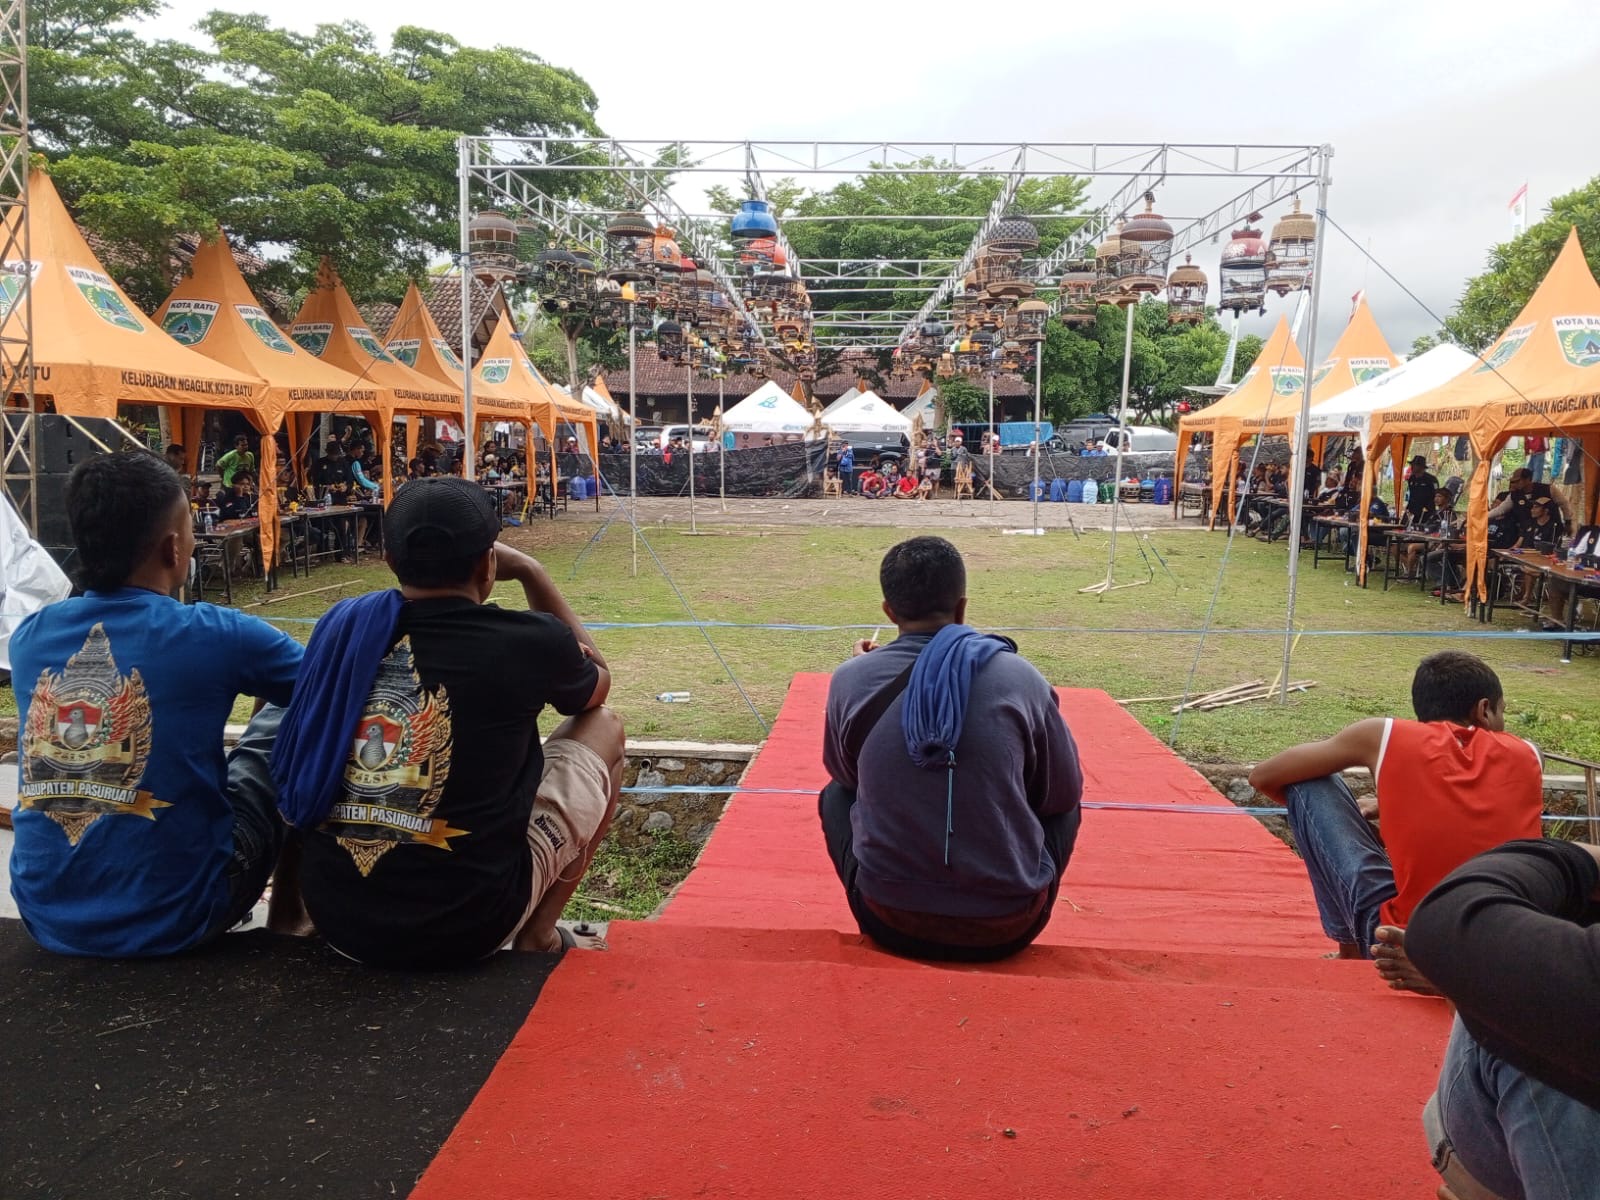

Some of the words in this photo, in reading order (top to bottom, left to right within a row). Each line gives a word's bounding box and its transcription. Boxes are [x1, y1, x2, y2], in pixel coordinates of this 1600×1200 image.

[69, 269, 91, 281] KOTA
[194, 303, 217, 311] BATU
[1556, 318, 1585, 326] KOTA
[121, 370, 177, 389] KELURAHAN
[178, 379, 214, 394] NGAGLIK
[215, 383, 234, 396] KOTA
[234, 384, 253, 397] BATU
[288, 388, 325, 401] KELURAHAN
[1505, 402, 1550, 417] KELURAHAN
[1551, 396, 1588, 414] NGAGLIK
[1383, 410, 1411, 423] KELURAHAN
[1437, 409, 1452, 422] KOTA
[1453, 408, 1471, 421] BATU
[22, 782, 75, 797] KABUPATEN
[78, 782, 138, 804] PASURUAN
[370, 808, 432, 833] PASURUAN
